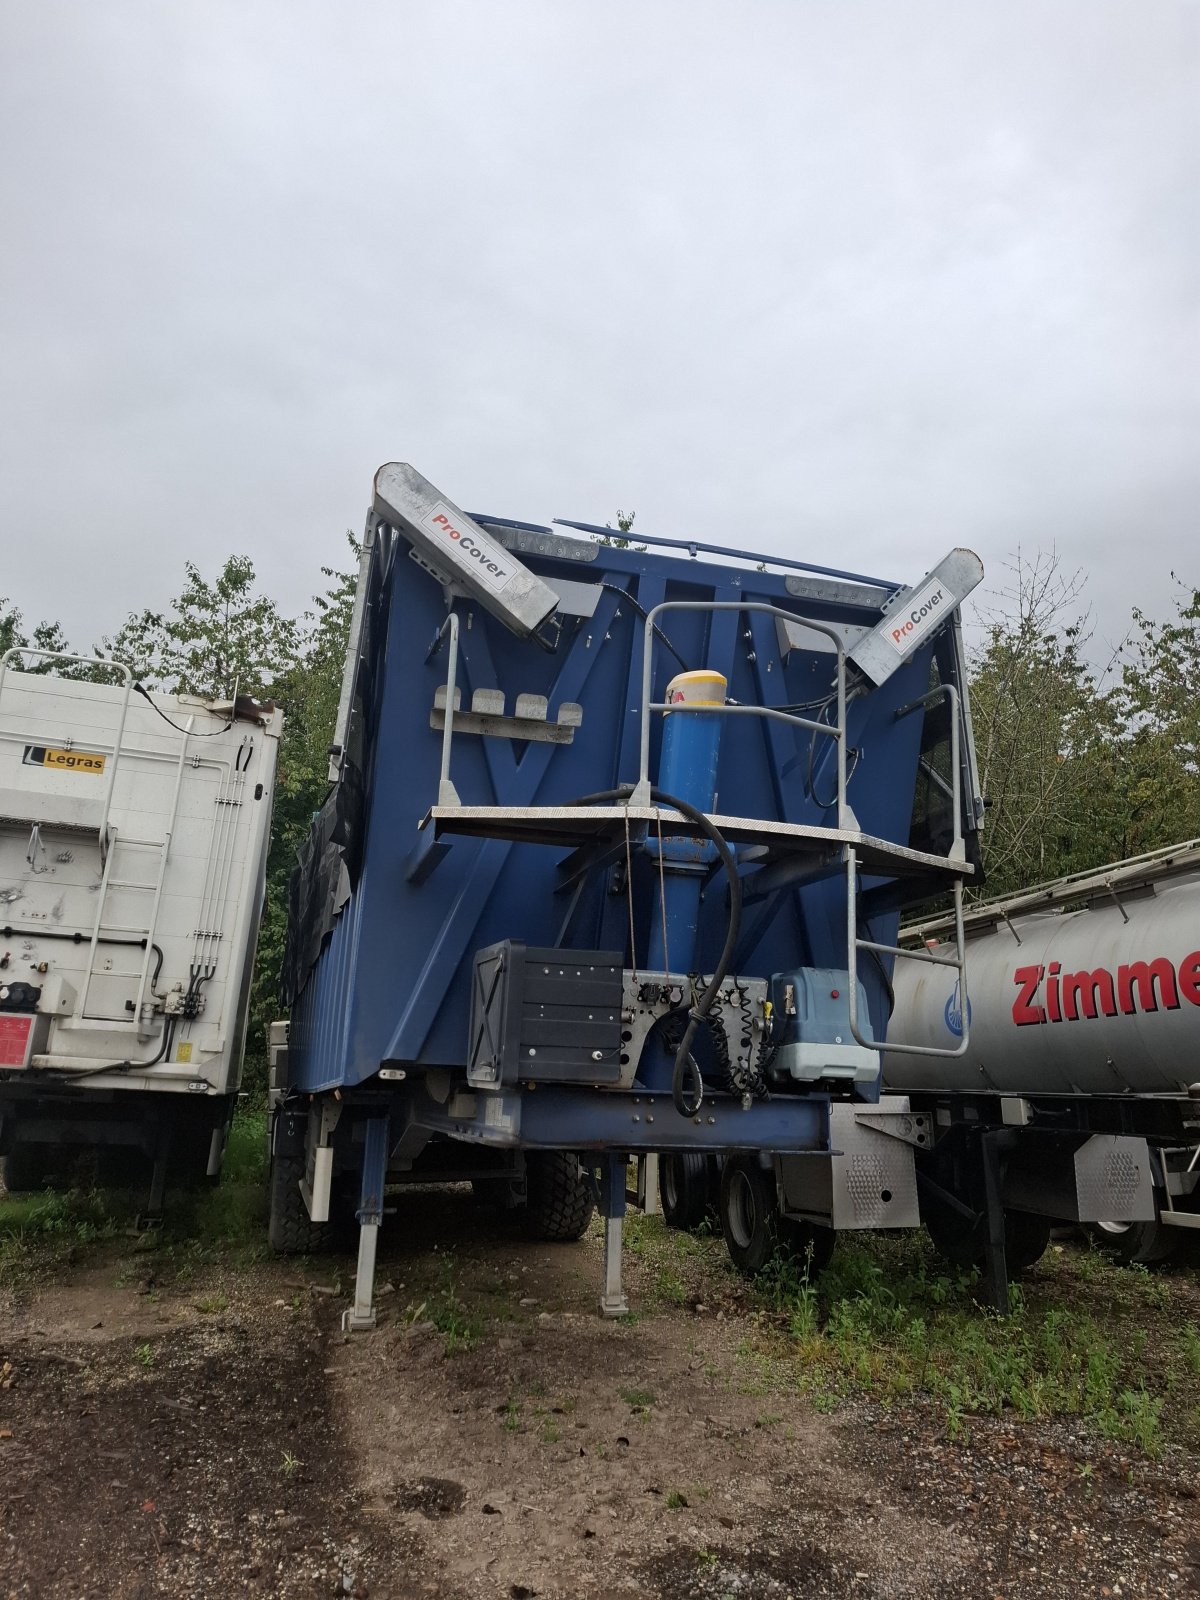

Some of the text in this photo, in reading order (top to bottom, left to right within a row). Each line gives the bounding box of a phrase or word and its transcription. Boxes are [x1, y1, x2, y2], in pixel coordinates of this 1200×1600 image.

[432, 514, 506, 577] ProCover
[892, 590, 943, 643] ProCover
[47, 752, 102, 768] Legras
